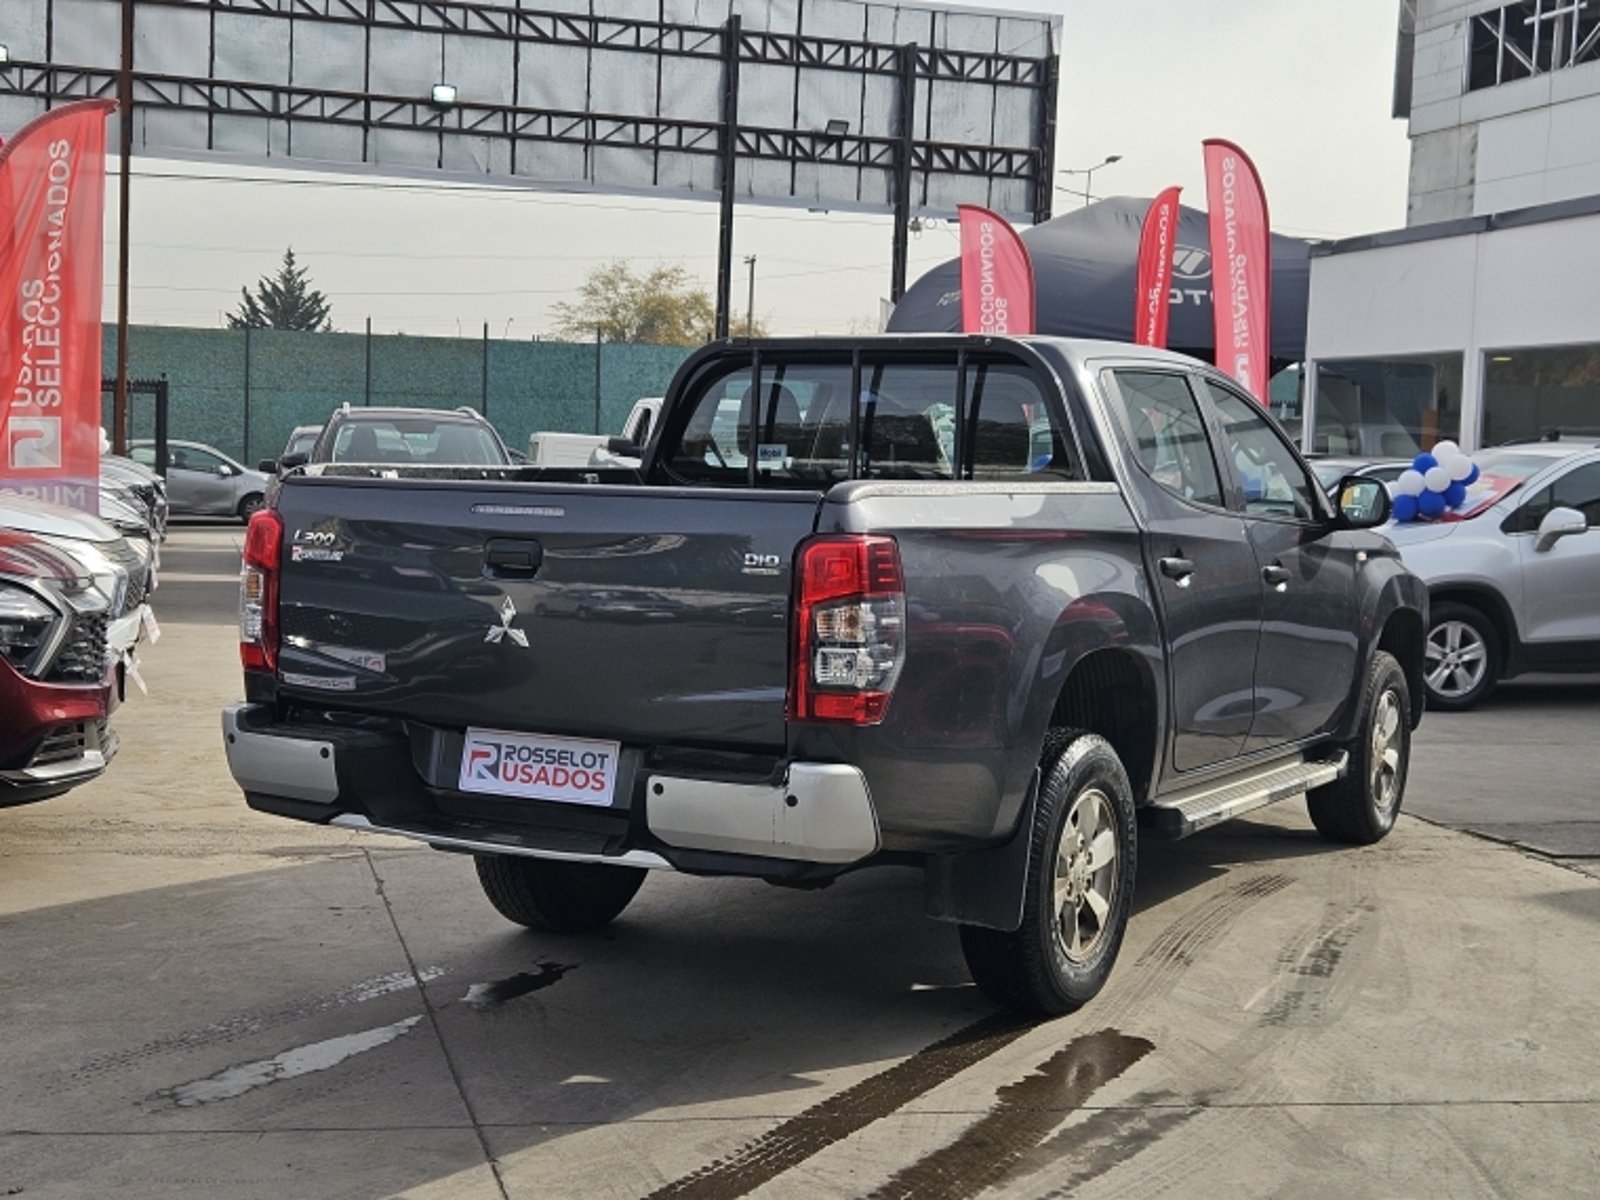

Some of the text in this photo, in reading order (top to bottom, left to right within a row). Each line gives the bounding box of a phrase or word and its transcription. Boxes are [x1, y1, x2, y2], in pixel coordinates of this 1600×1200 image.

[36, 138, 71, 408] SELECCIONADOS
[504, 745, 609, 769] ROSSELOT
[502, 762, 606, 792] USADOS
